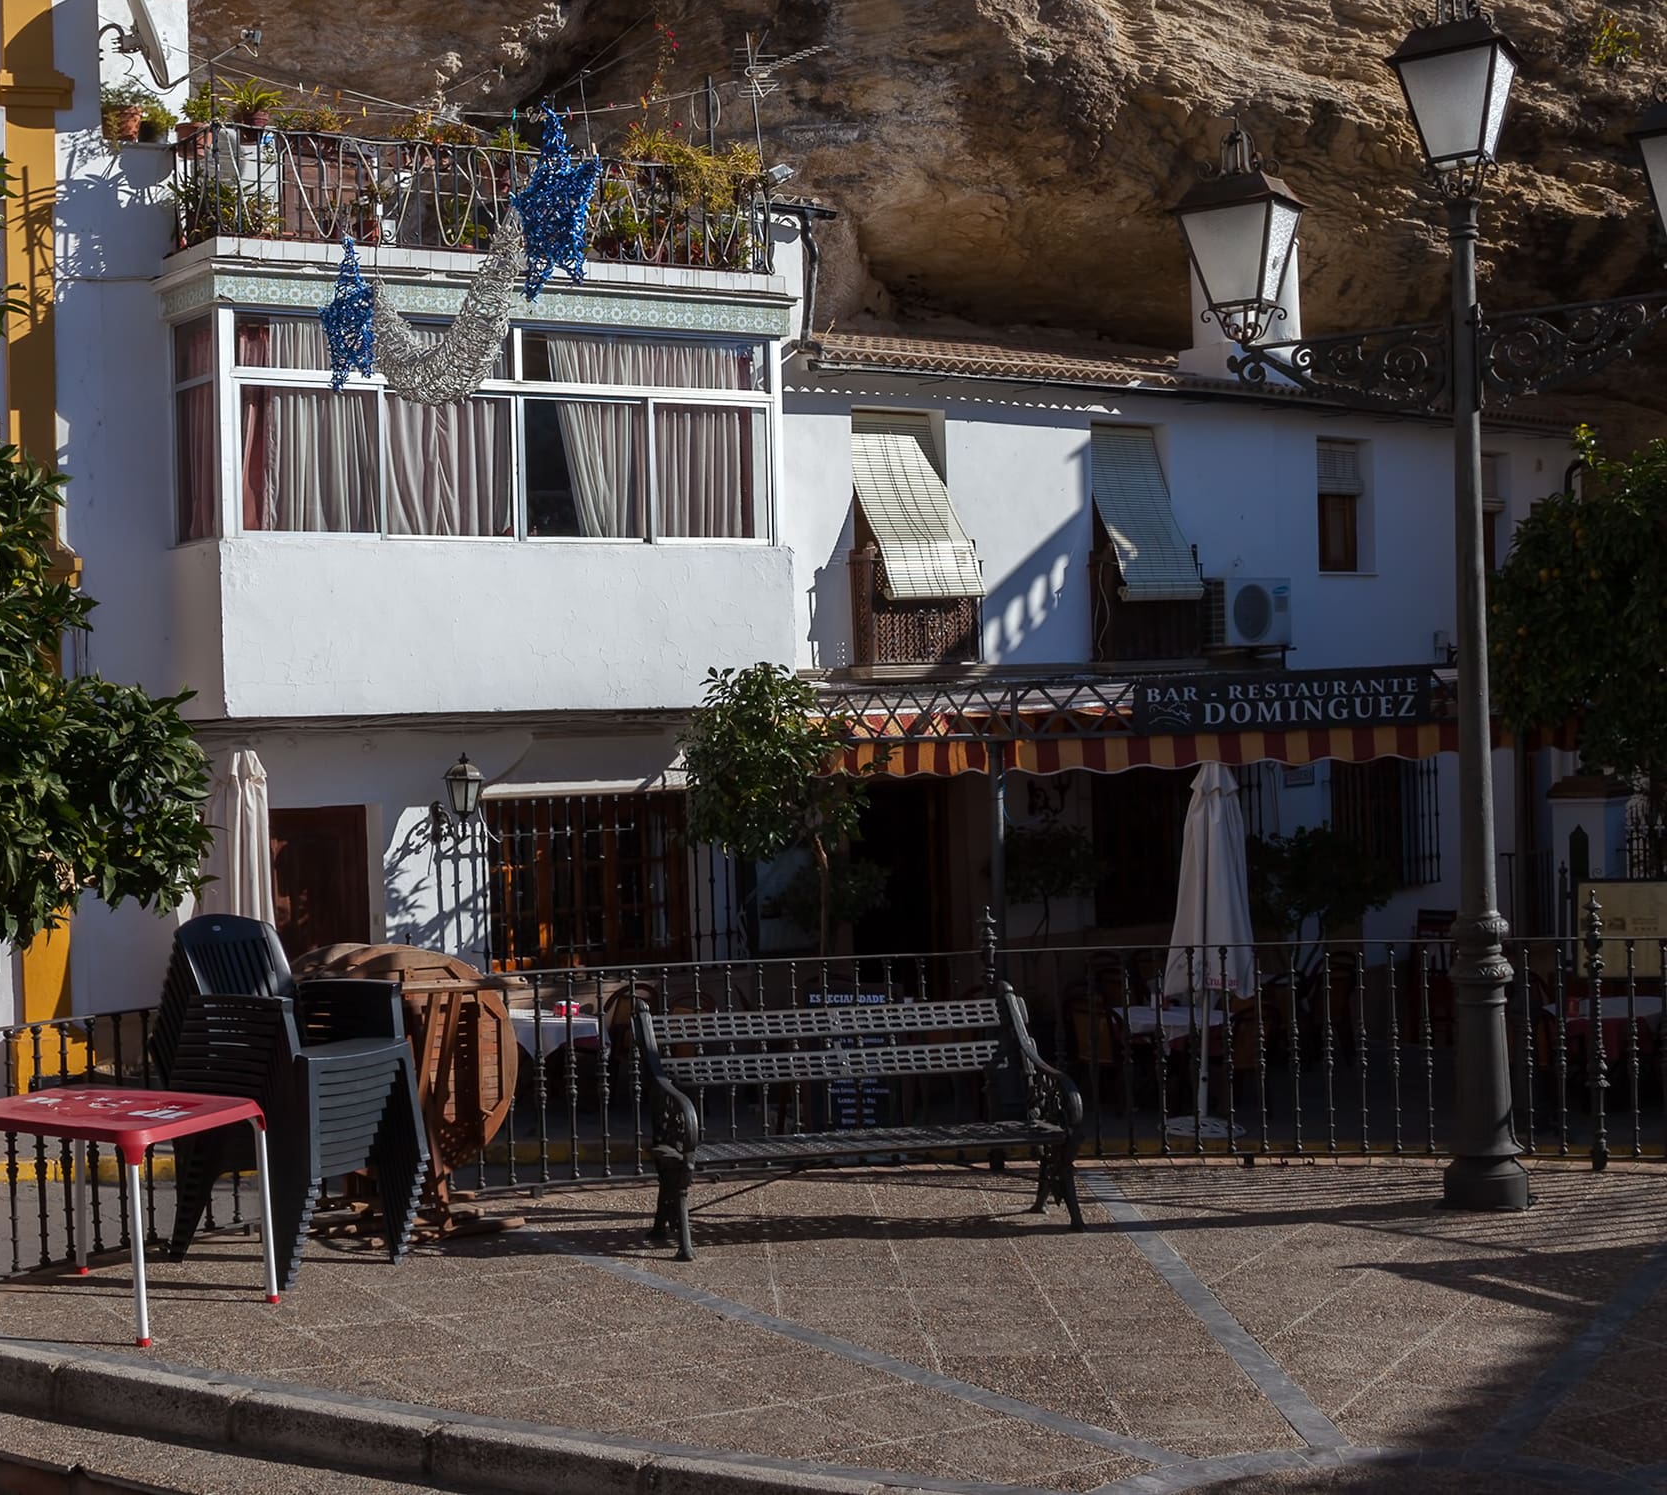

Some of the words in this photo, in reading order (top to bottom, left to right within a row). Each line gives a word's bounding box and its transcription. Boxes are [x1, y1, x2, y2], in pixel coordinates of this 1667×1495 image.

[1147, 686, 1198, 703] BAR
[1228, 678, 1418, 700] RESTAURANTE
[1204, 695, 1416, 725] DOMINGUEZ
